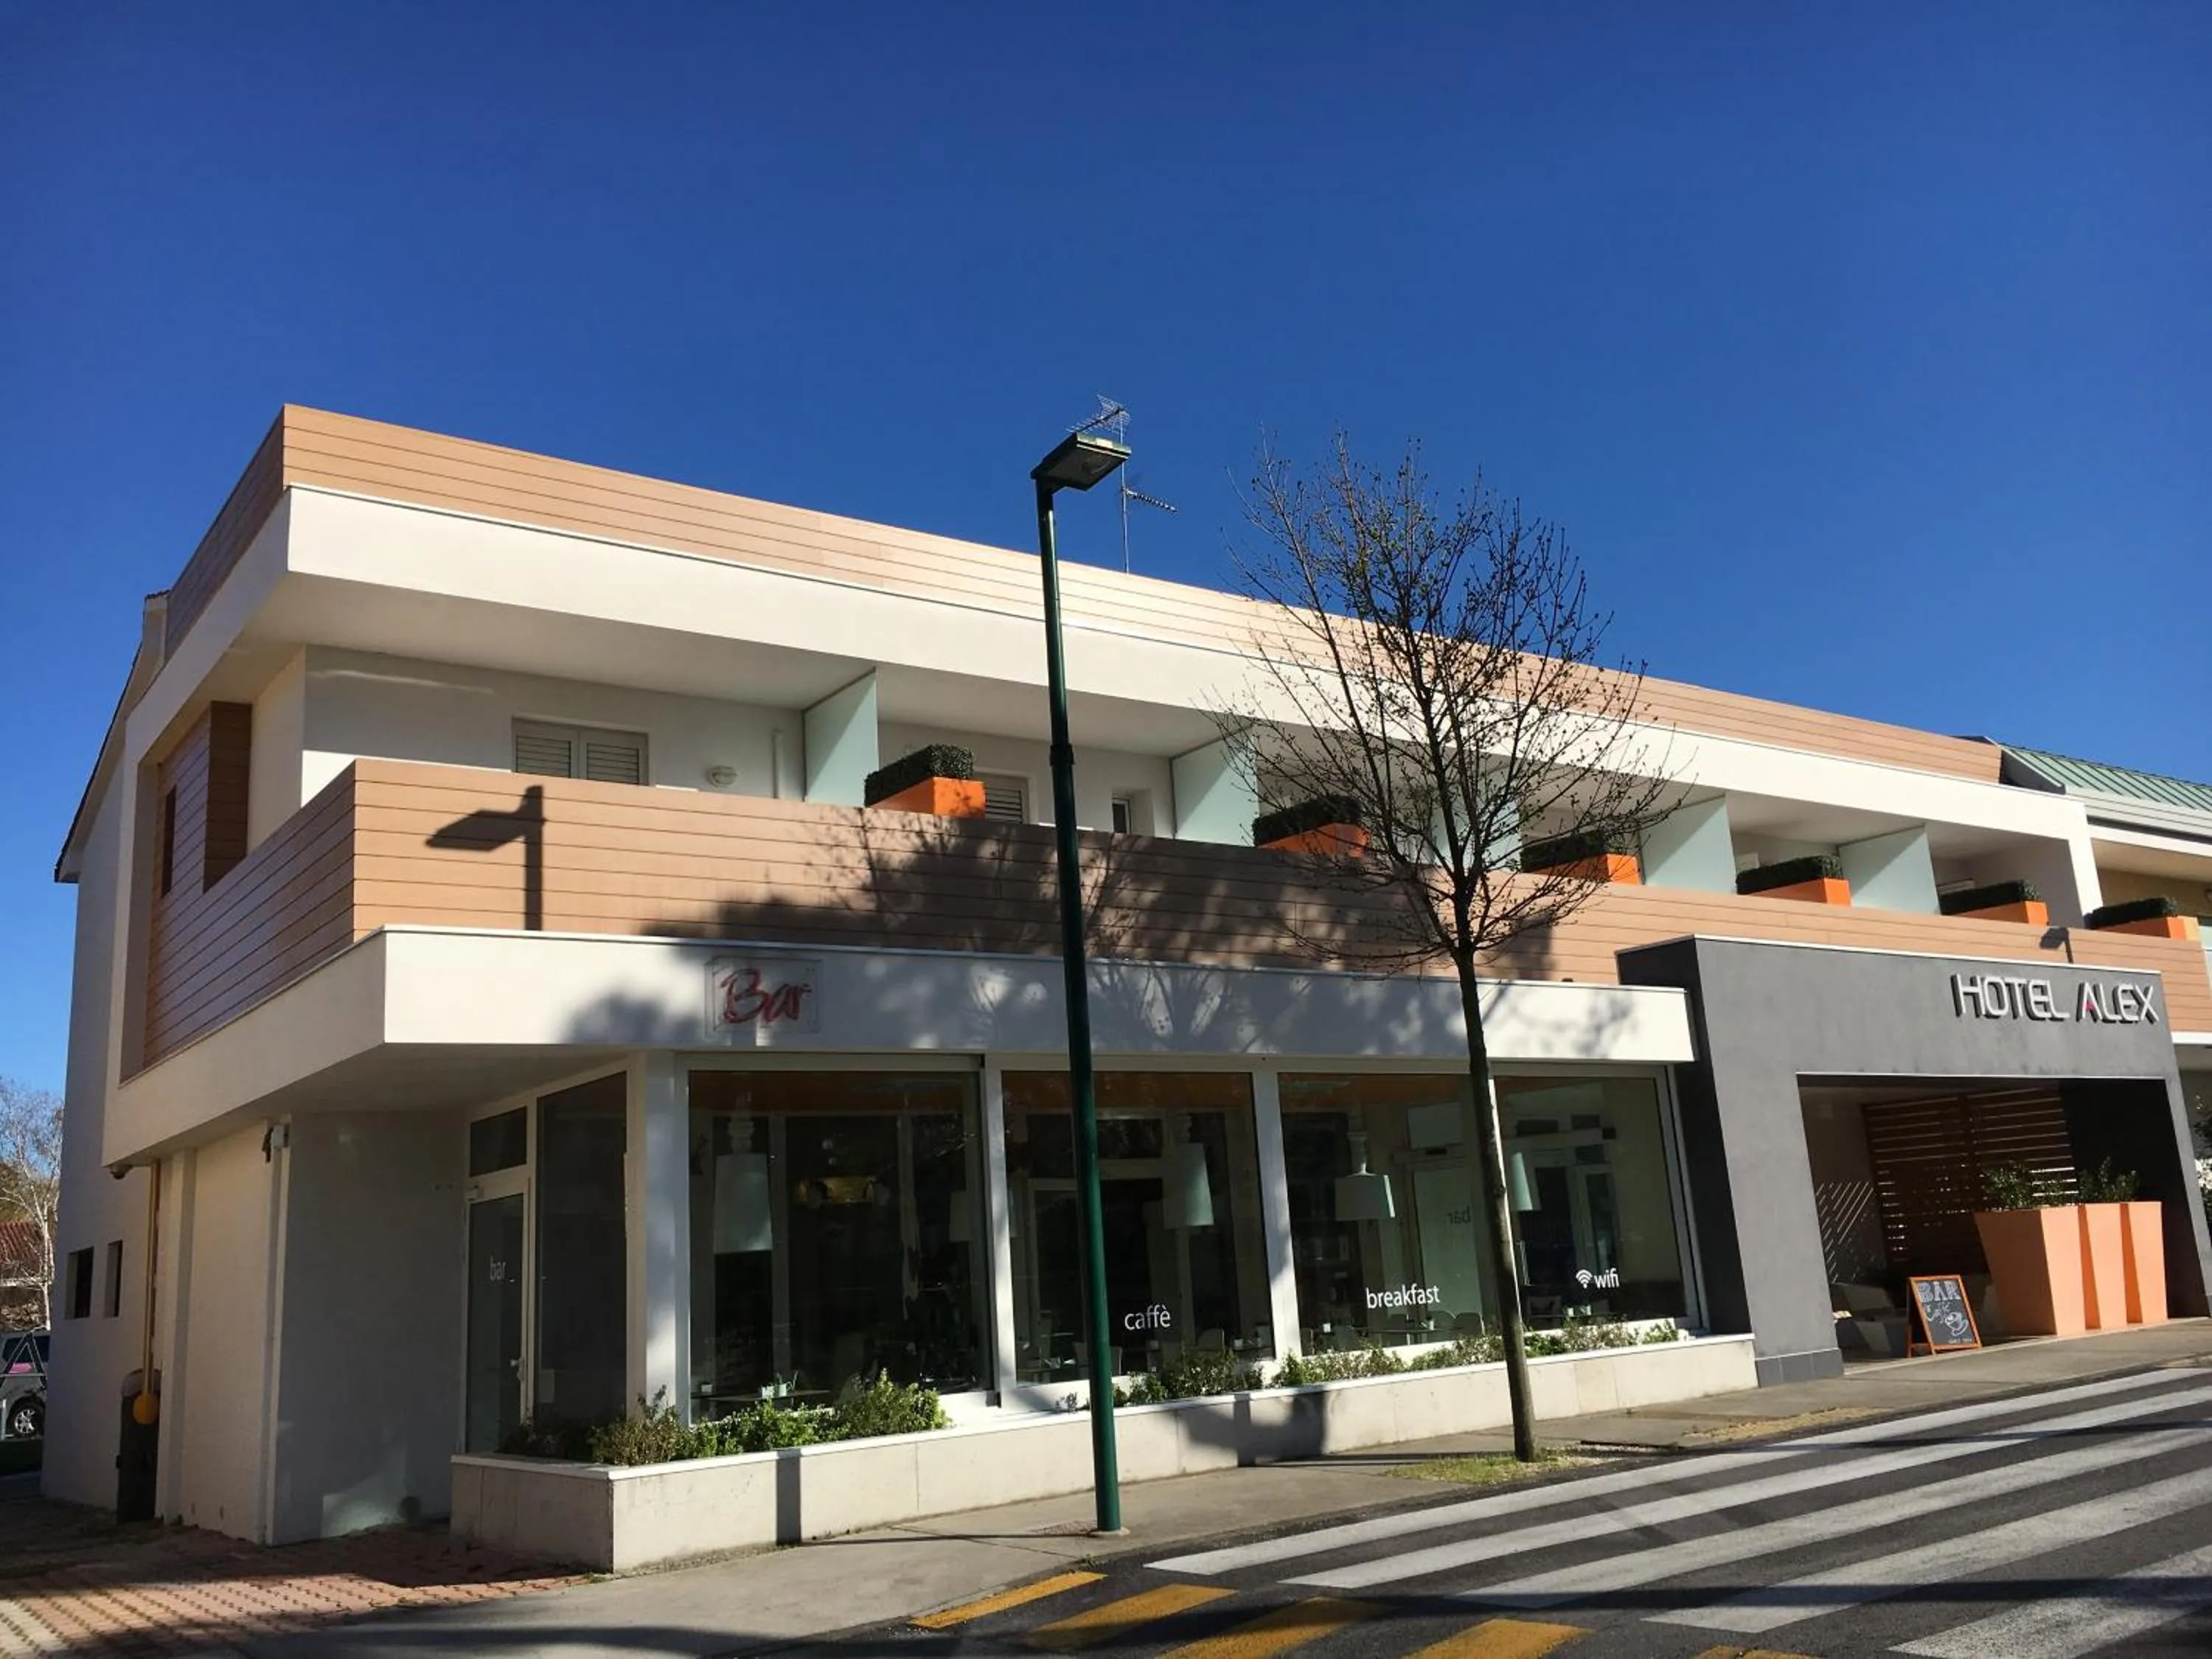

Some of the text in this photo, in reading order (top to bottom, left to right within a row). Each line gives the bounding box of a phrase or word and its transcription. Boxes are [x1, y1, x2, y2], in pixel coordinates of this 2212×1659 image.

[720, 967, 812, 1024] Bar
[1952, 973, 2160, 1025] HOTEL ALEX
[490, 1255, 507, 1281] bar
[1593, 1267, 1620, 1289] wifi
[1366, 1283, 1440, 1309] breakfast
[1917, 1281, 1961, 1303] BAR
[1124, 1304, 1171, 1331] caffè
